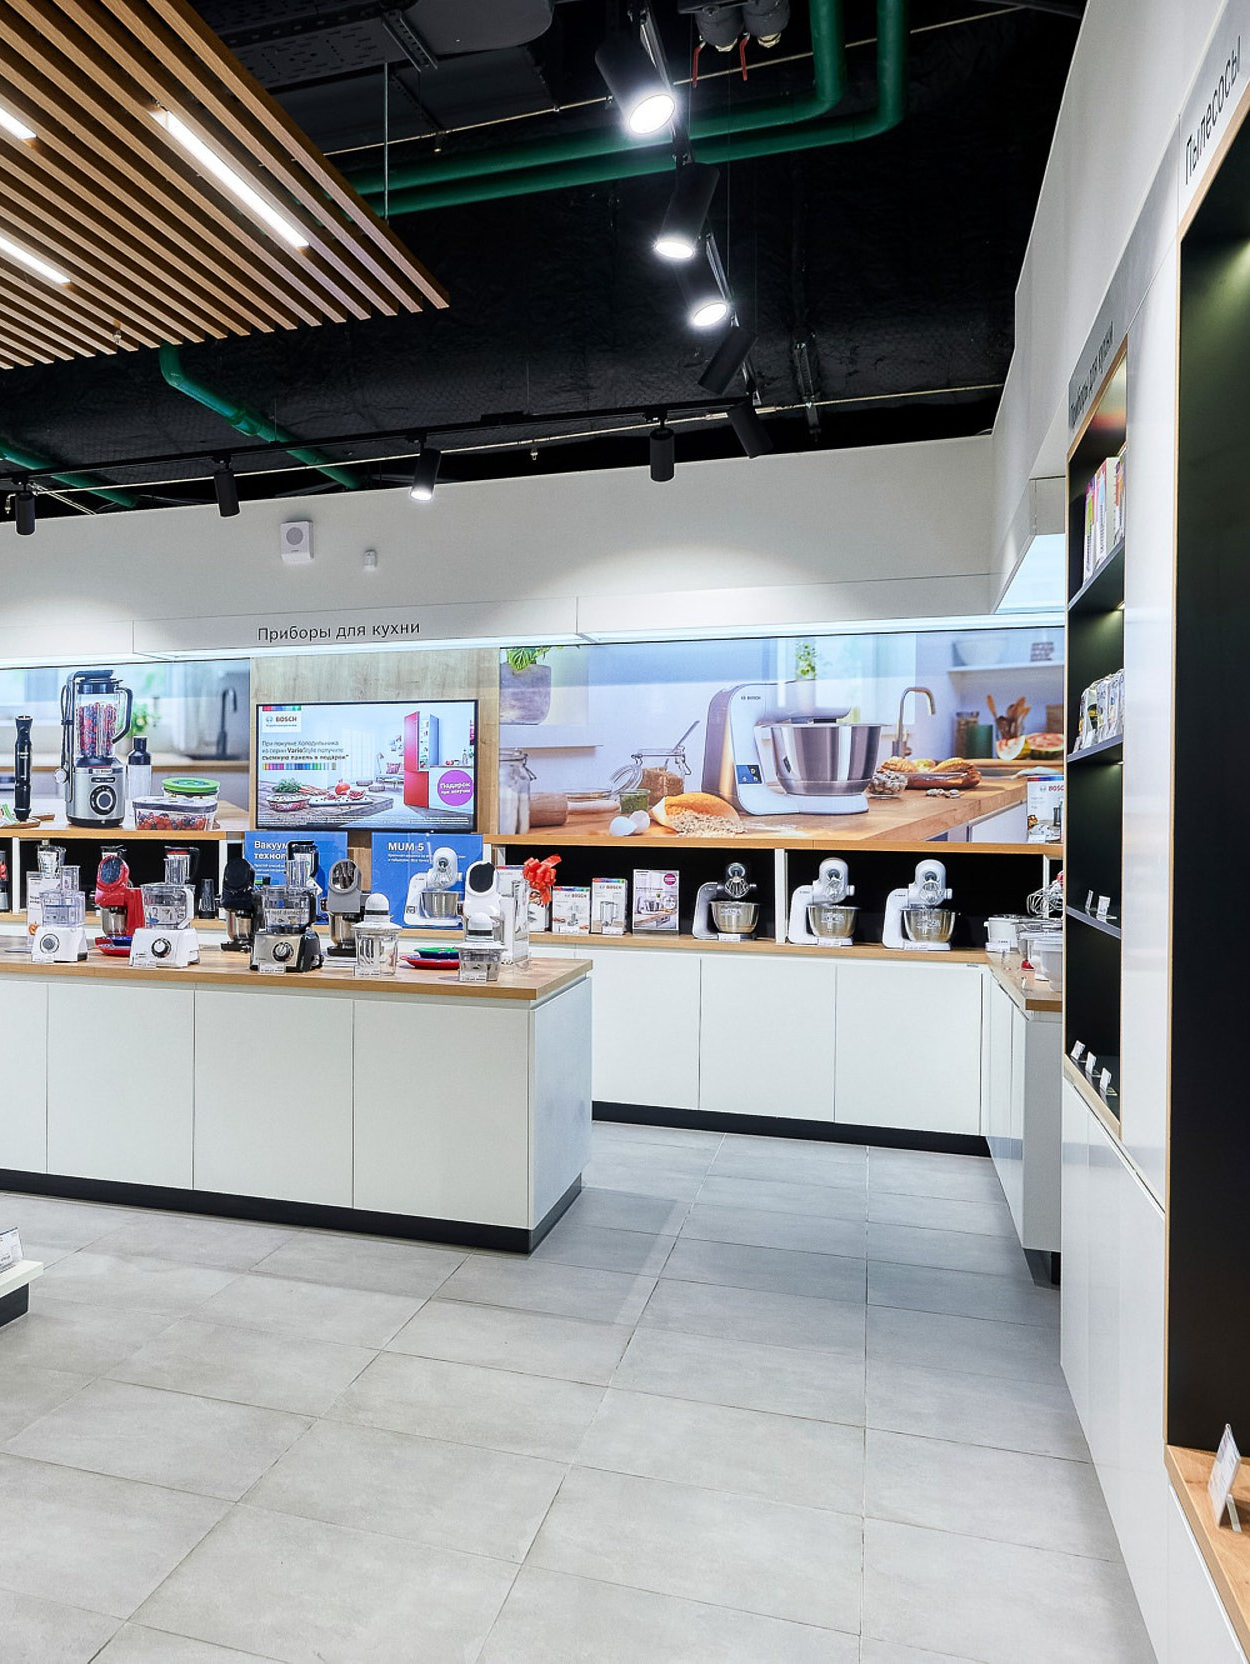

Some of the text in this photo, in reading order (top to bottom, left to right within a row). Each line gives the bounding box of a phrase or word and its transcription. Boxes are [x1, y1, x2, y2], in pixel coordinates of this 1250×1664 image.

[1185, 35, 1241, 185] Пылесосы
[258, 623, 420, 643] Приборы для кухни
[388, 842, 425, 852] MUM 5
